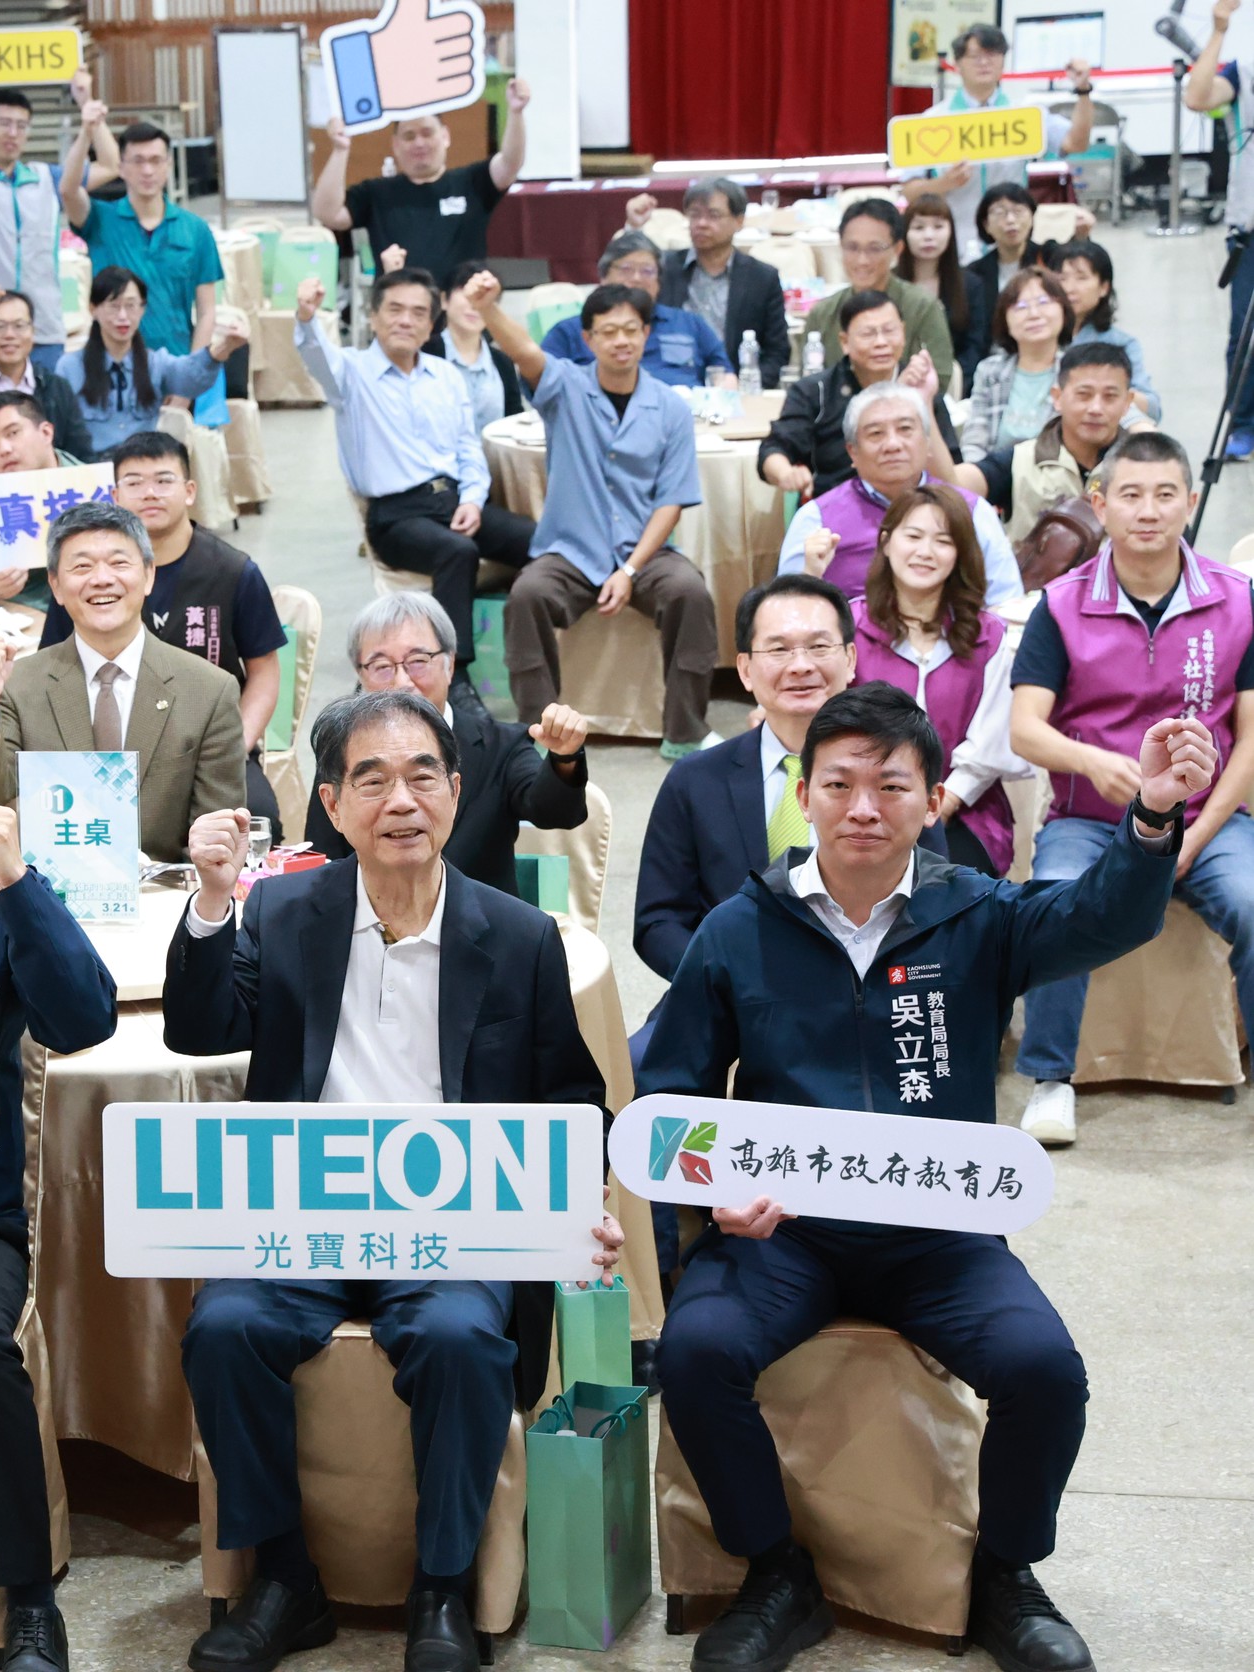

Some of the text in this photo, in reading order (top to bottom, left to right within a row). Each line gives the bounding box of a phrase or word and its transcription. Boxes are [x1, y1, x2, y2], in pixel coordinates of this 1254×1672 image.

[958, 119, 1028, 150] KIHS
[185, 605, 206, 648] 黃捷
[54, 818, 112, 846] 主桌
[907, 963, 941, 972] KAOHSIUNG
[908, 972, 942, 981] GOVERNMENT
[891, 994, 934, 1104] 吳立森
[927, 990, 951, 1079] 教育局局長
[134, 1117, 569, 1212] LITEON
[729, 1138, 1024, 1201] 高雄市政府教育局
[254, 1231, 450, 1270] 光寶科技
